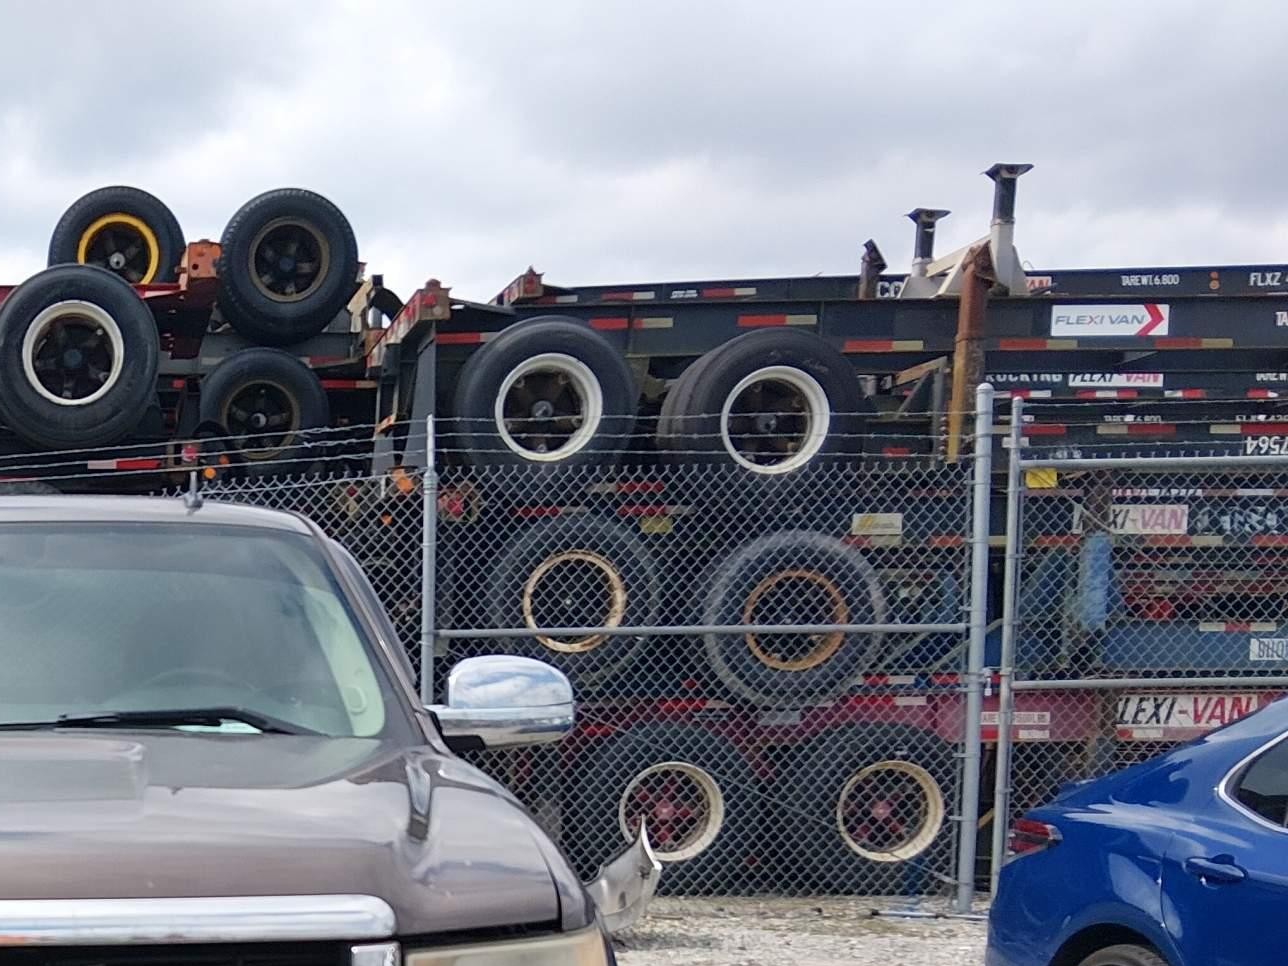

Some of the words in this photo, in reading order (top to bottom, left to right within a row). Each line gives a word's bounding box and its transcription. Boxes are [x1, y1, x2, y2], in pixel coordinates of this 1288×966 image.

[1249, 272, 1281, 287] FLXZ
[1054, 315, 1105, 326] FLEXI
[1108, 315, 1146, 326] VAN
[1114, 697, 1253, 726] LEXI-VAN
